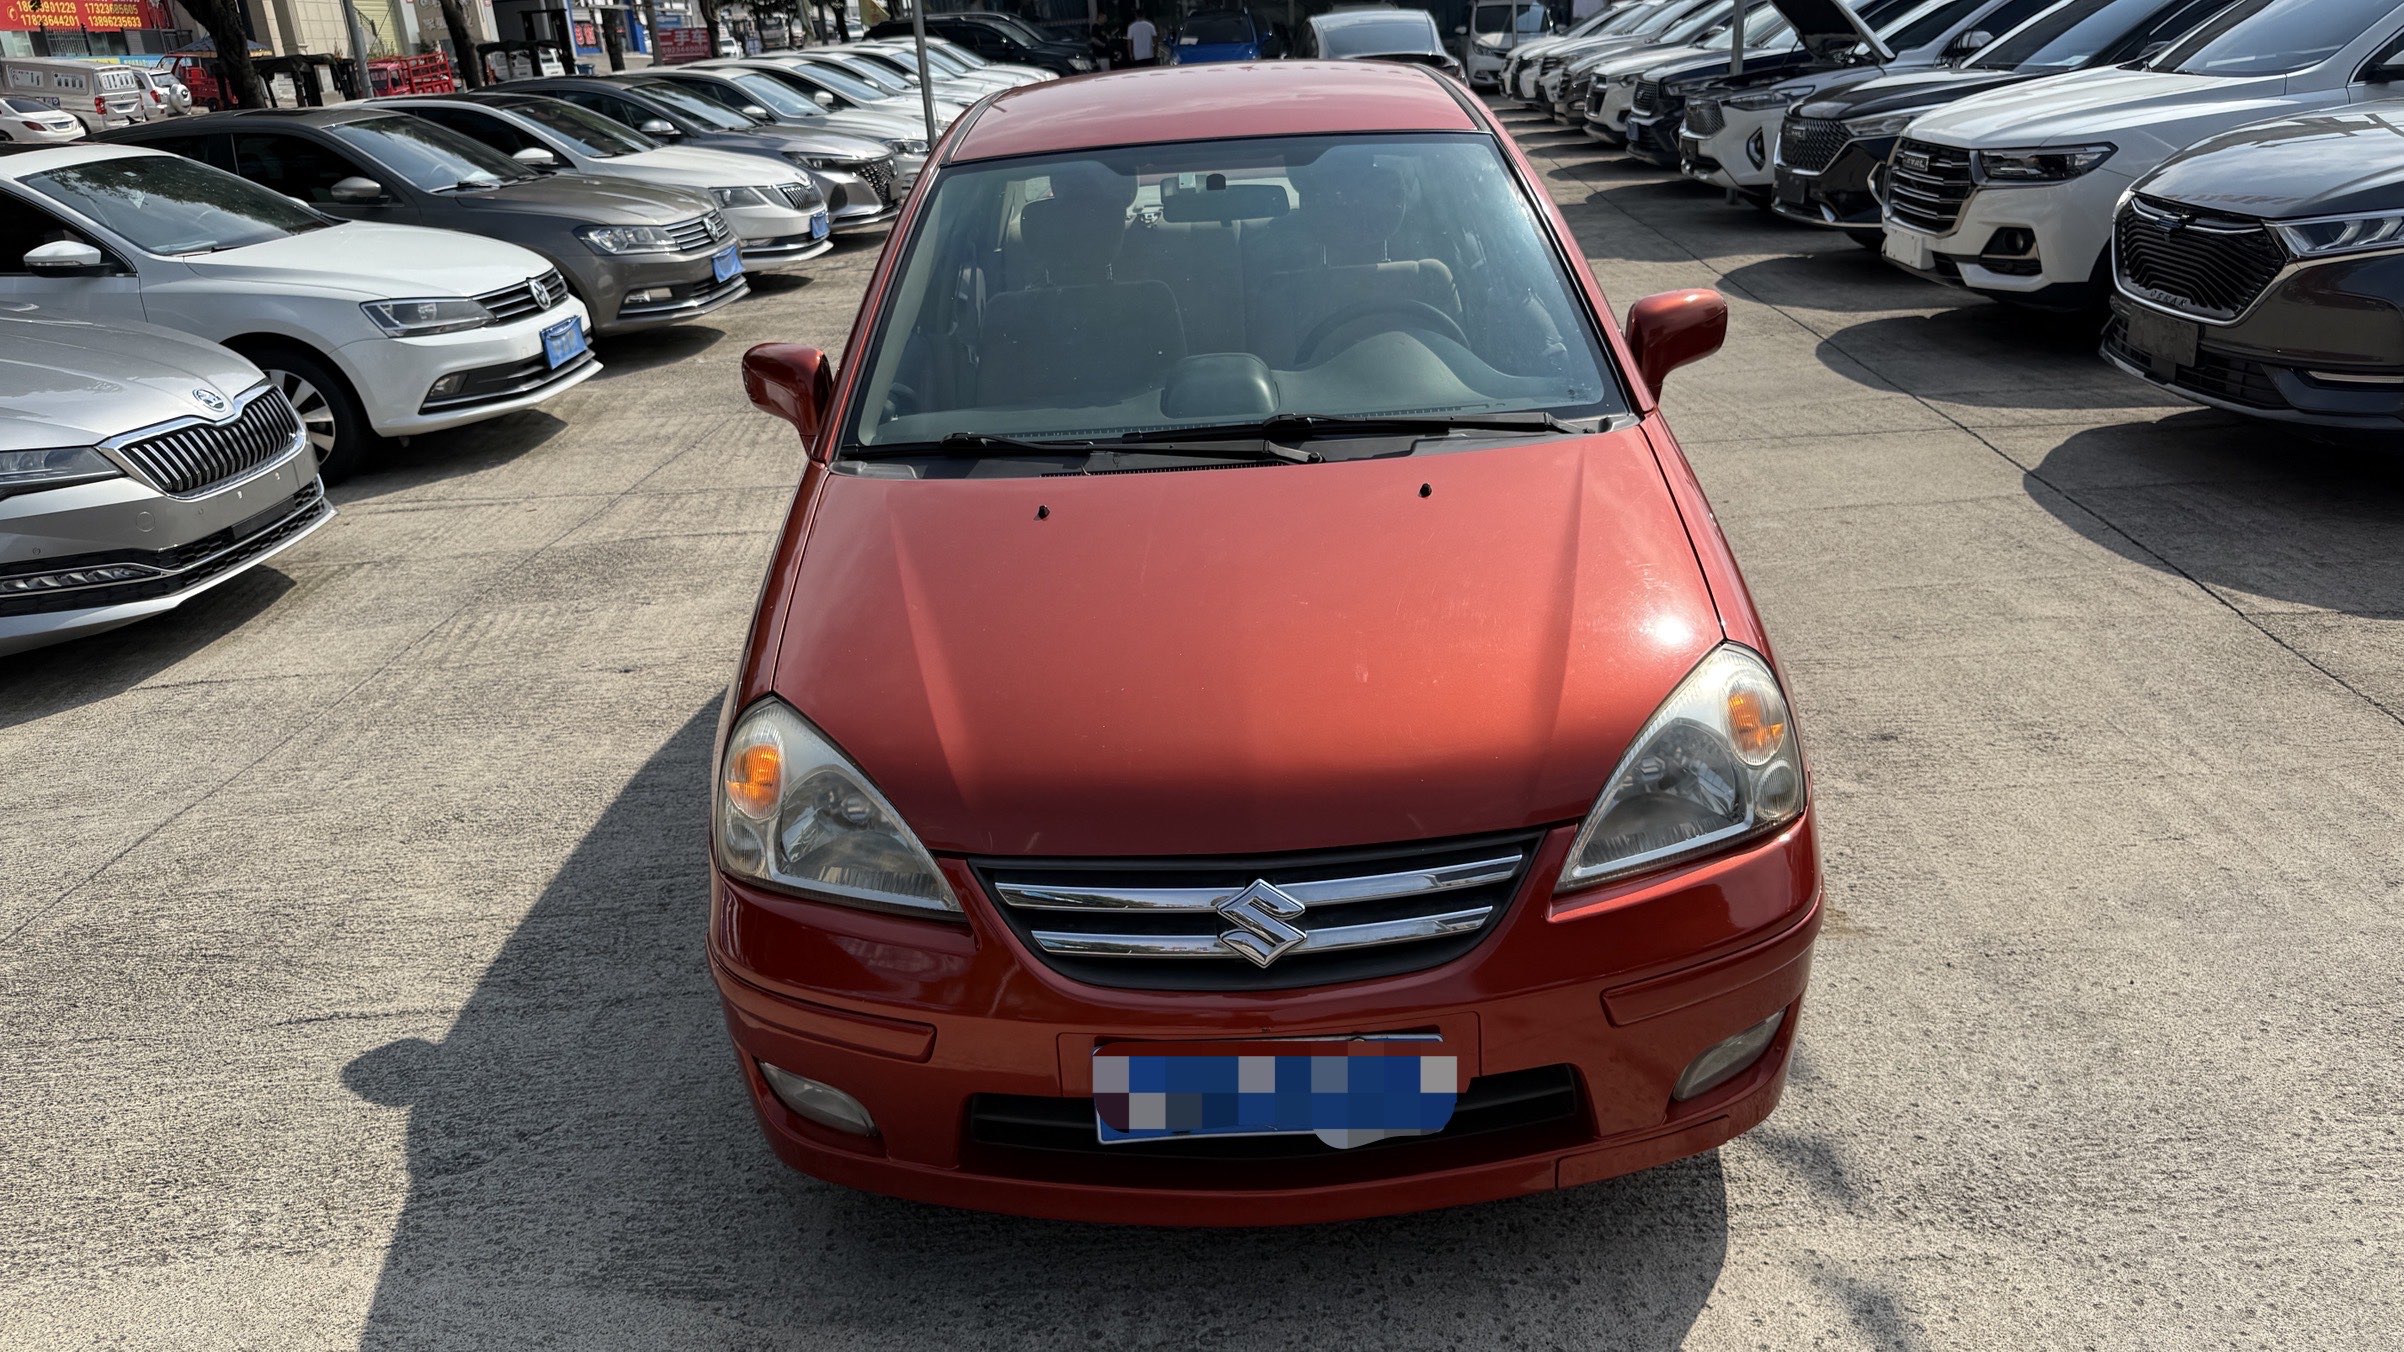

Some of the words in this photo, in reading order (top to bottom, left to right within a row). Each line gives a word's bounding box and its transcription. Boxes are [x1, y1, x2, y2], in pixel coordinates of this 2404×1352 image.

[16, 0, 77, 13] 18901229
[20, 14, 80, 27] 17823644201
[88, 15, 142, 28] 13896235633
[657, 29, 708, 48] 二手车
